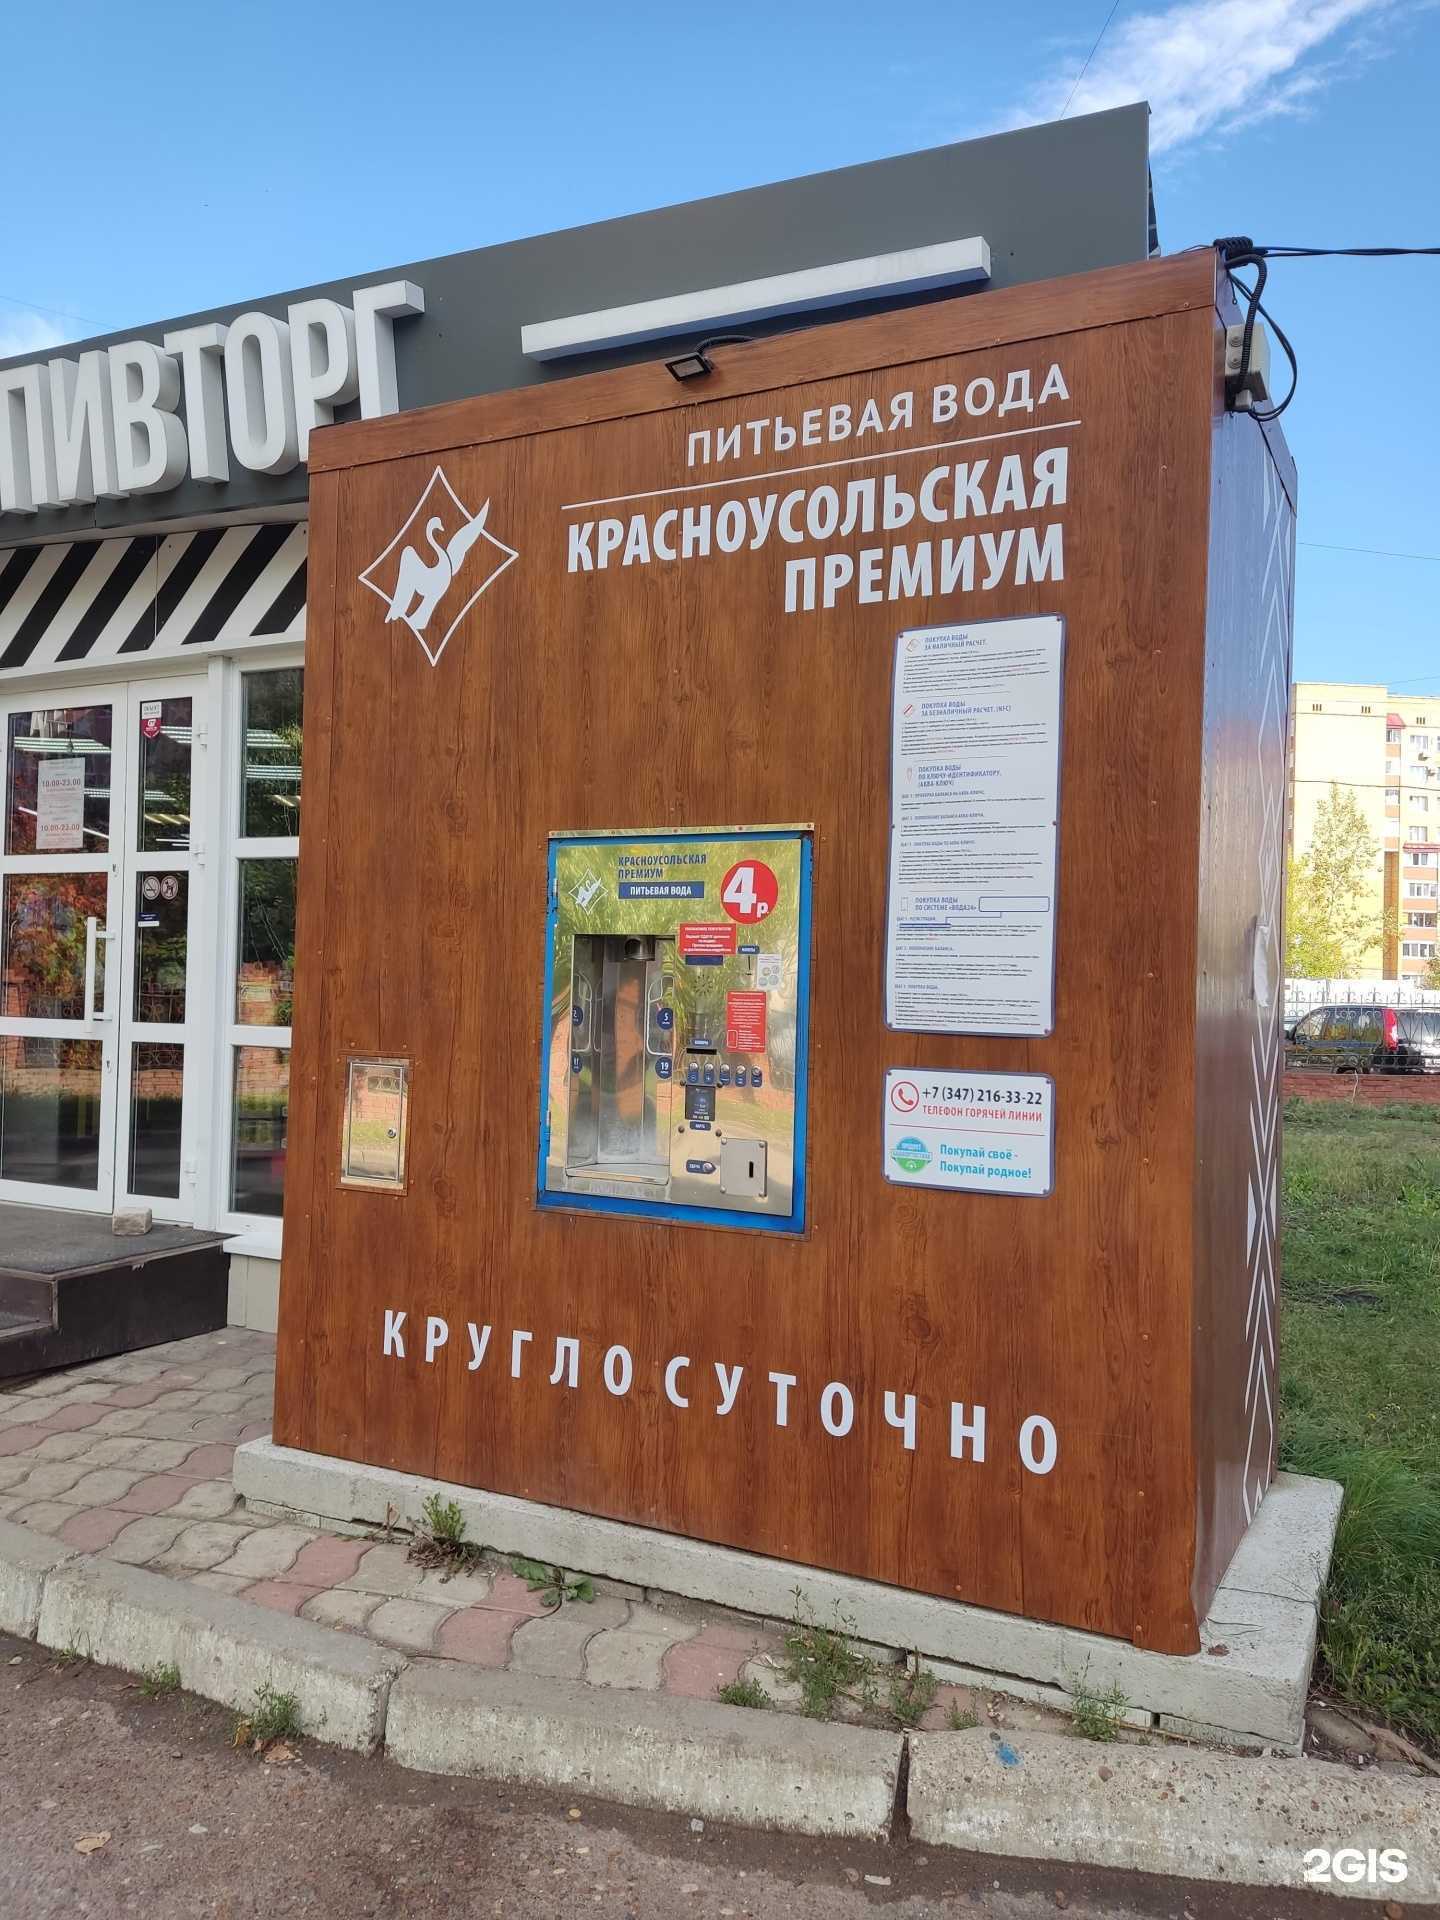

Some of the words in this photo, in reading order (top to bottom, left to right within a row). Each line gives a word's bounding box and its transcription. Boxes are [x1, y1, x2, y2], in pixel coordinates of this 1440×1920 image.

[0, 280, 425, 516] ПИВТОРГ
[687, 391, 915, 467] ПИТЬЕВАЯ
[932, 363, 1071, 423] ВОДА
[567, 446, 1069, 573] КРАСНОУСОЛЬСКАЯ
[784, 523, 1065, 613] ПРЕМИУМ
[618, 854, 707, 866] КРАСНОУСОЛЬСКАЯ
[618, 869, 664, 880] ПРЕМИУМ
[630, 886, 669, 896] ПИТЬЕВАЯ
[671, 885, 692, 897] ВОДА
[922, 1086, 938, 1098] +7
[942, 1087, 974, 1103] (347)
[977, 1089, 1043, 1105] 216-33-22
[922, 1104, 963, 1116] ТЕЛЕФОН
[965, 1106, 1006, 1119] ГОРЯЧЕЙ
[1008, 1111, 1042, 1122] ЛИНИИ
[940, 1144, 985, 1159] Покупай
[940, 1160, 985, 1175] Покупай
[987, 1167, 1032, 1179] родное!
[383, 1309, 1058, 1475] КРУГЛОСУТОЧНО
